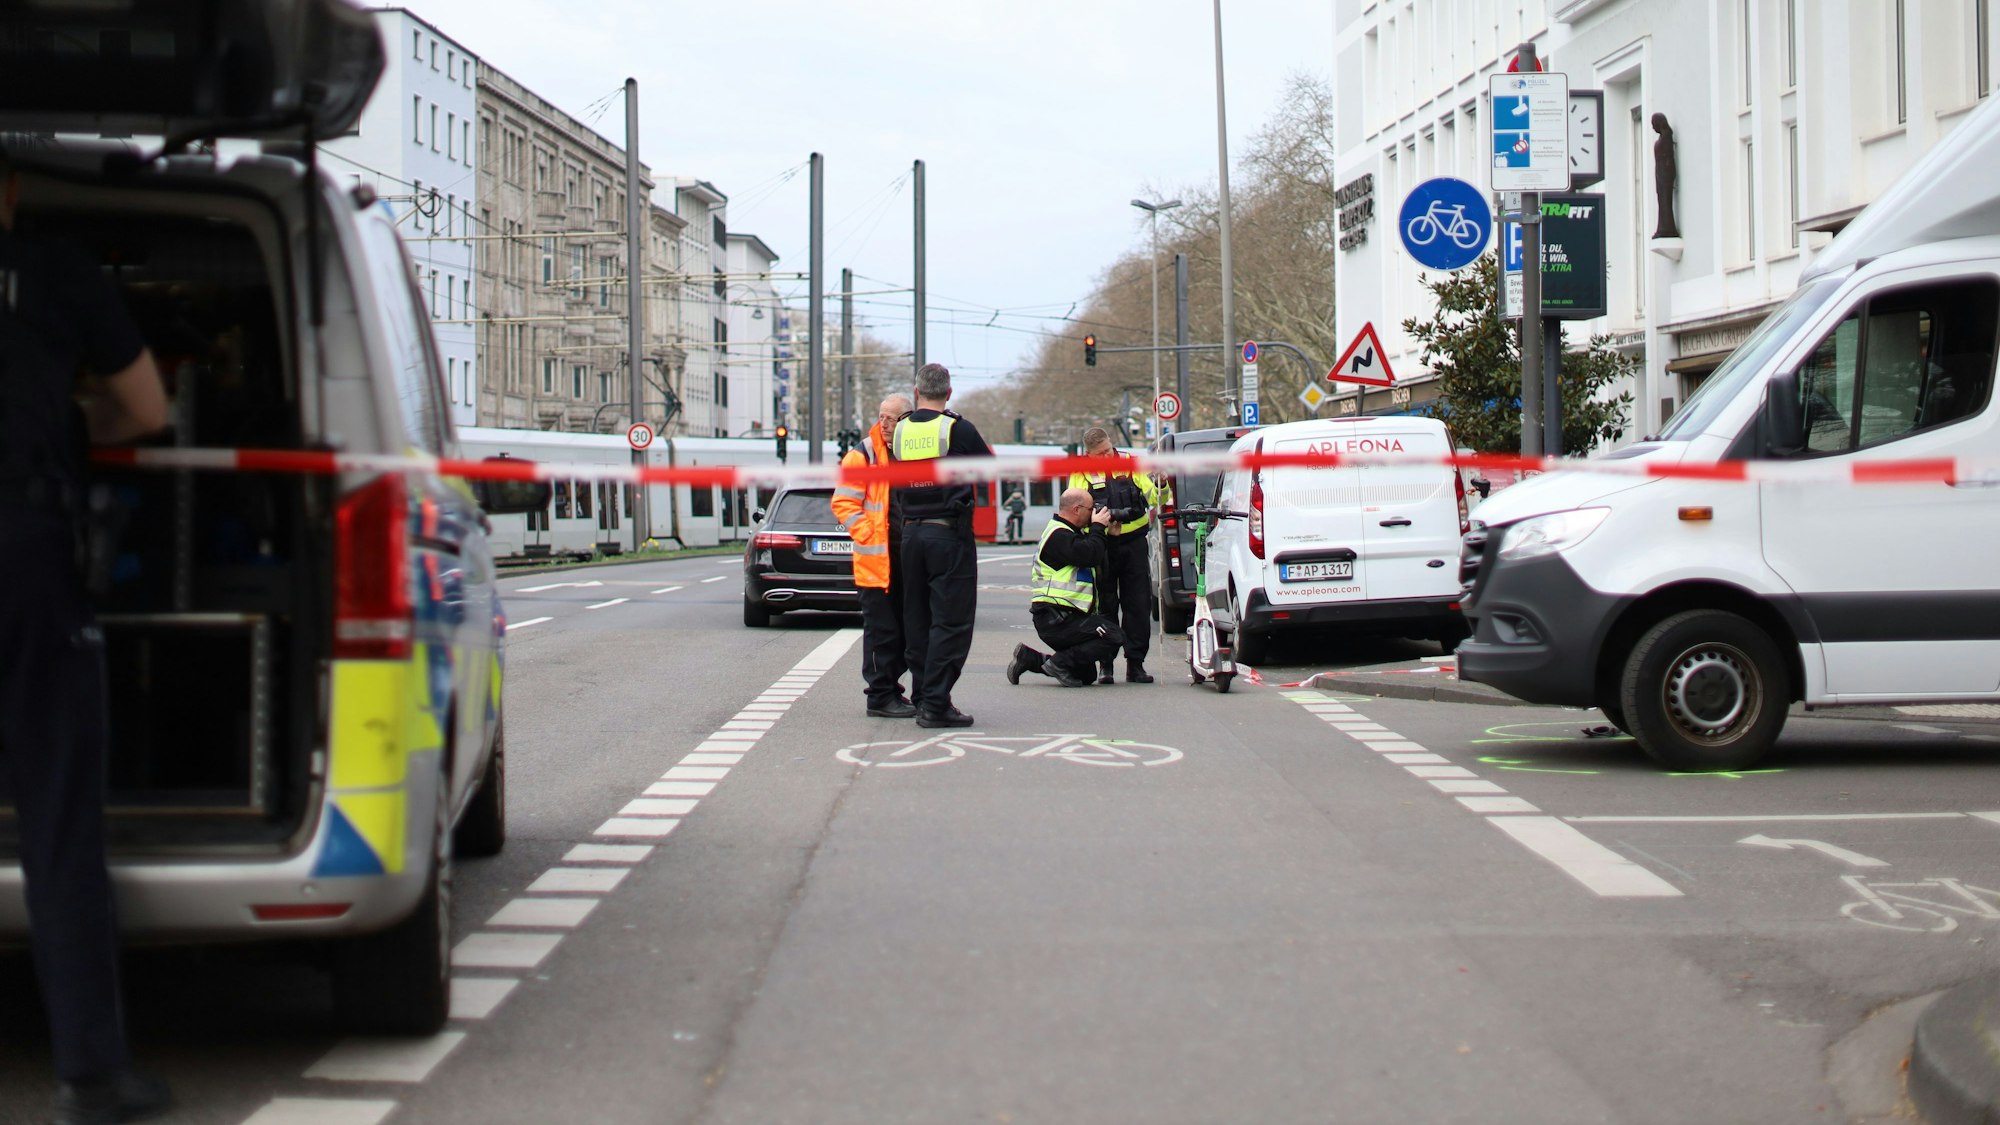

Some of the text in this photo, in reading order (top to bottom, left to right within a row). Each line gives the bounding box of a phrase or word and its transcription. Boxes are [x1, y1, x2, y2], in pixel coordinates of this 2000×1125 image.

[1541, 203, 1593, 219] TRAFIT
[1549, 244, 1563, 253] DU,
[1550, 254, 1568, 263] WIR,
[1550, 263, 1572, 272] XTRA
[1159, 400, 1175, 413] 30
[1245, 405, 1254, 423] P
[633, 430, 648, 442] 30
[904, 437, 935, 450] POLIZEI
[1306, 439, 1405, 456] APLEONA
[821, 542, 851, 551] BM NM
[1288, 563, 1350, 578] F AP 1317
[1276, 585, 1361, 597] www.apleona.com
